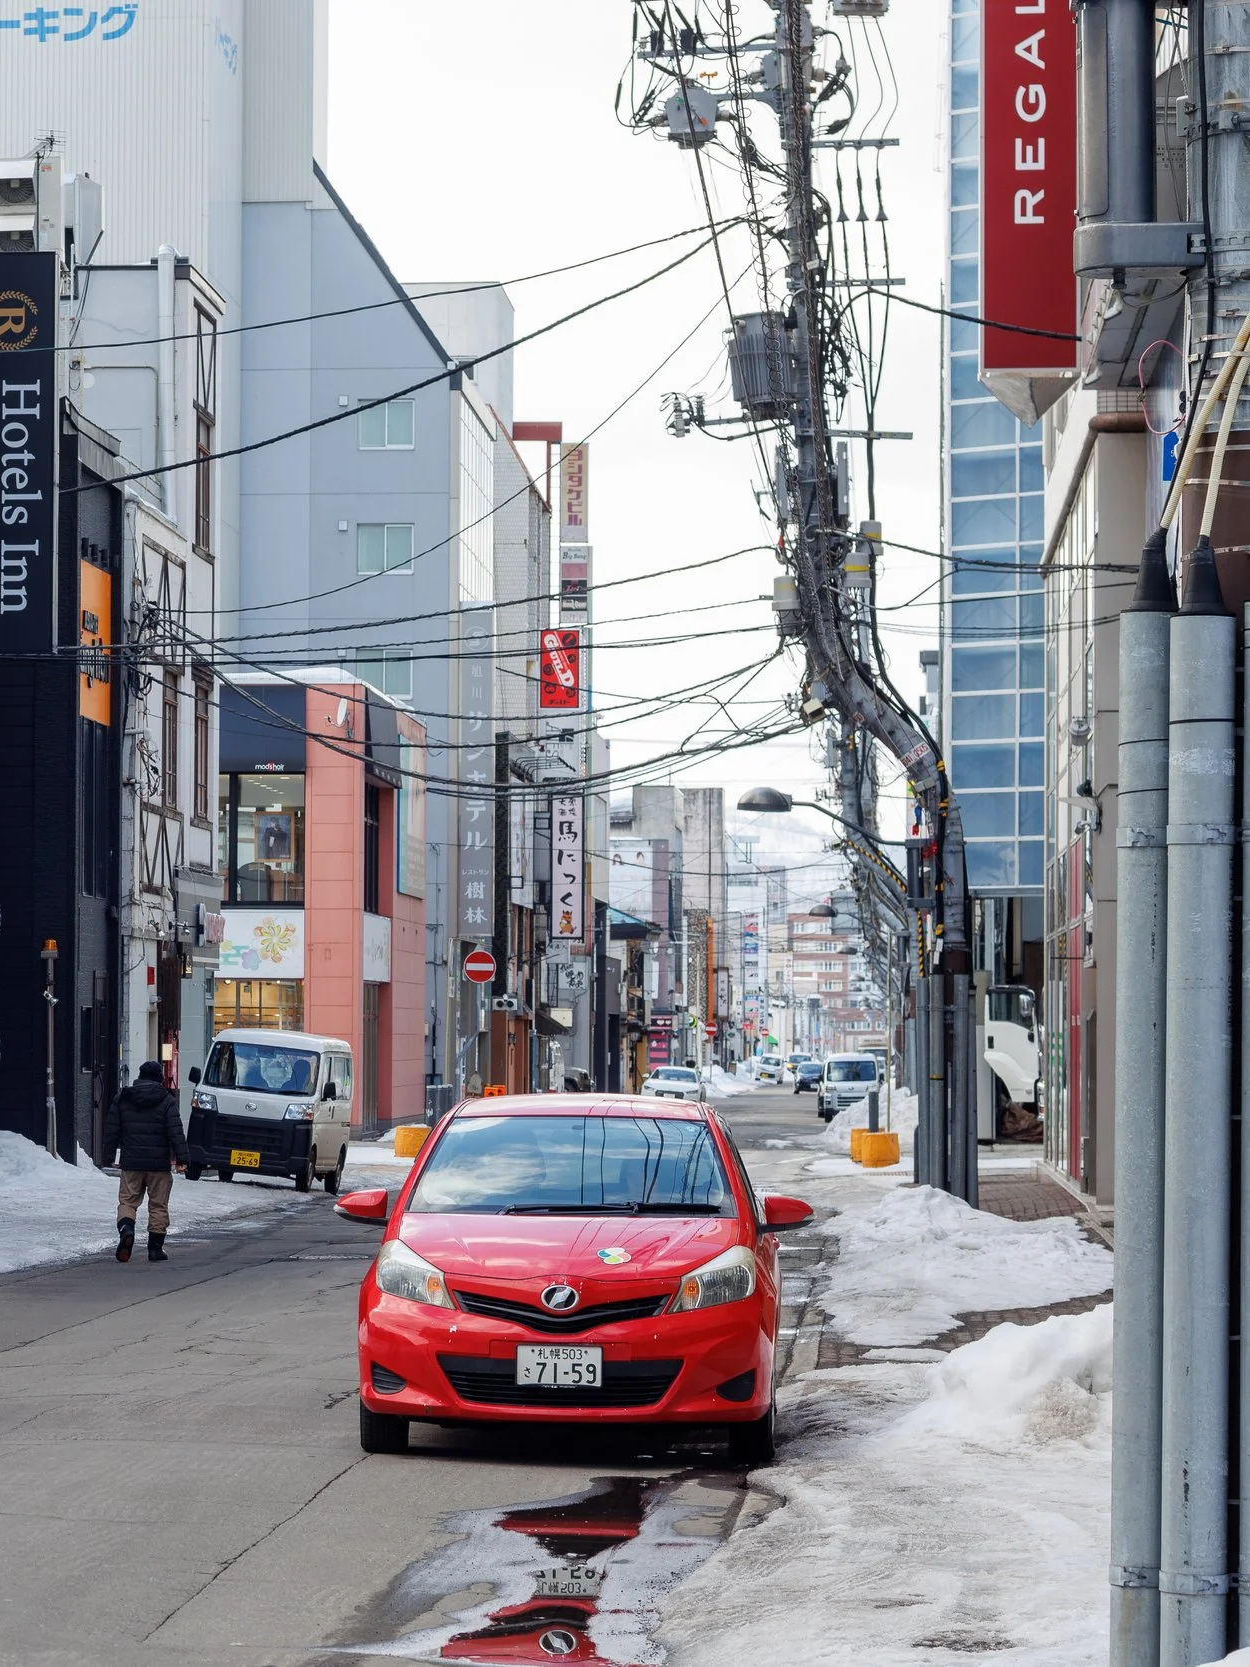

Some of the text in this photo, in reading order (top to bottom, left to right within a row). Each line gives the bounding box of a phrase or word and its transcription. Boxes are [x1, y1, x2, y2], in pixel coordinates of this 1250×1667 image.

[1014, 0, 1047, 225] REGAL
[0, 379, 43, 615] Hotels Inn
[464, 882, 488, 924] 樹林
[557, 821, 579, 906] 馬につく
[523, 1362, 597, 1385] さ 71-59
